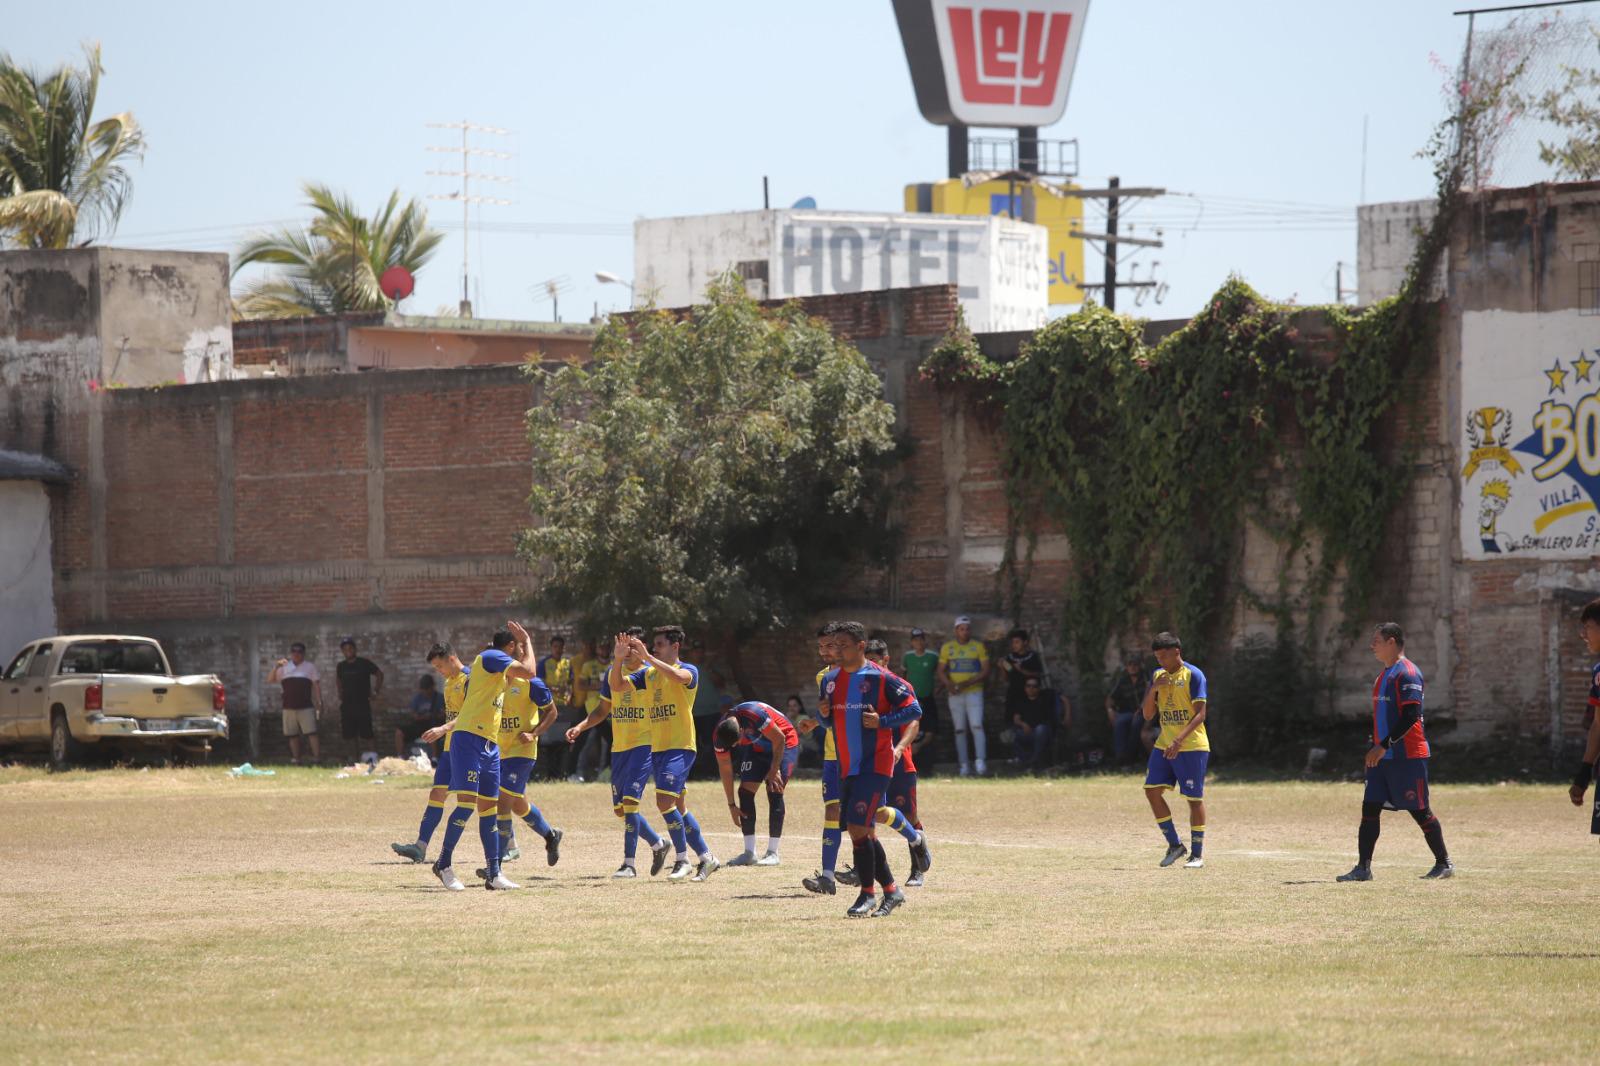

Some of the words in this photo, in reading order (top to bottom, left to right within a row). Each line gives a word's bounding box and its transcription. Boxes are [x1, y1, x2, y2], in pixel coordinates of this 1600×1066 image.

[946, 7, 1072, 107] Ley
[783, 225, 979, 298] HOTEL
[1540, 484, 1581, 512] VILLA
[1522, 535, 1573, 551] SEMILLERO
[1576, 533, 1592, 548] DE
[499, 716, 520, 729] BEC
[467, 770, 478, 783] 22
